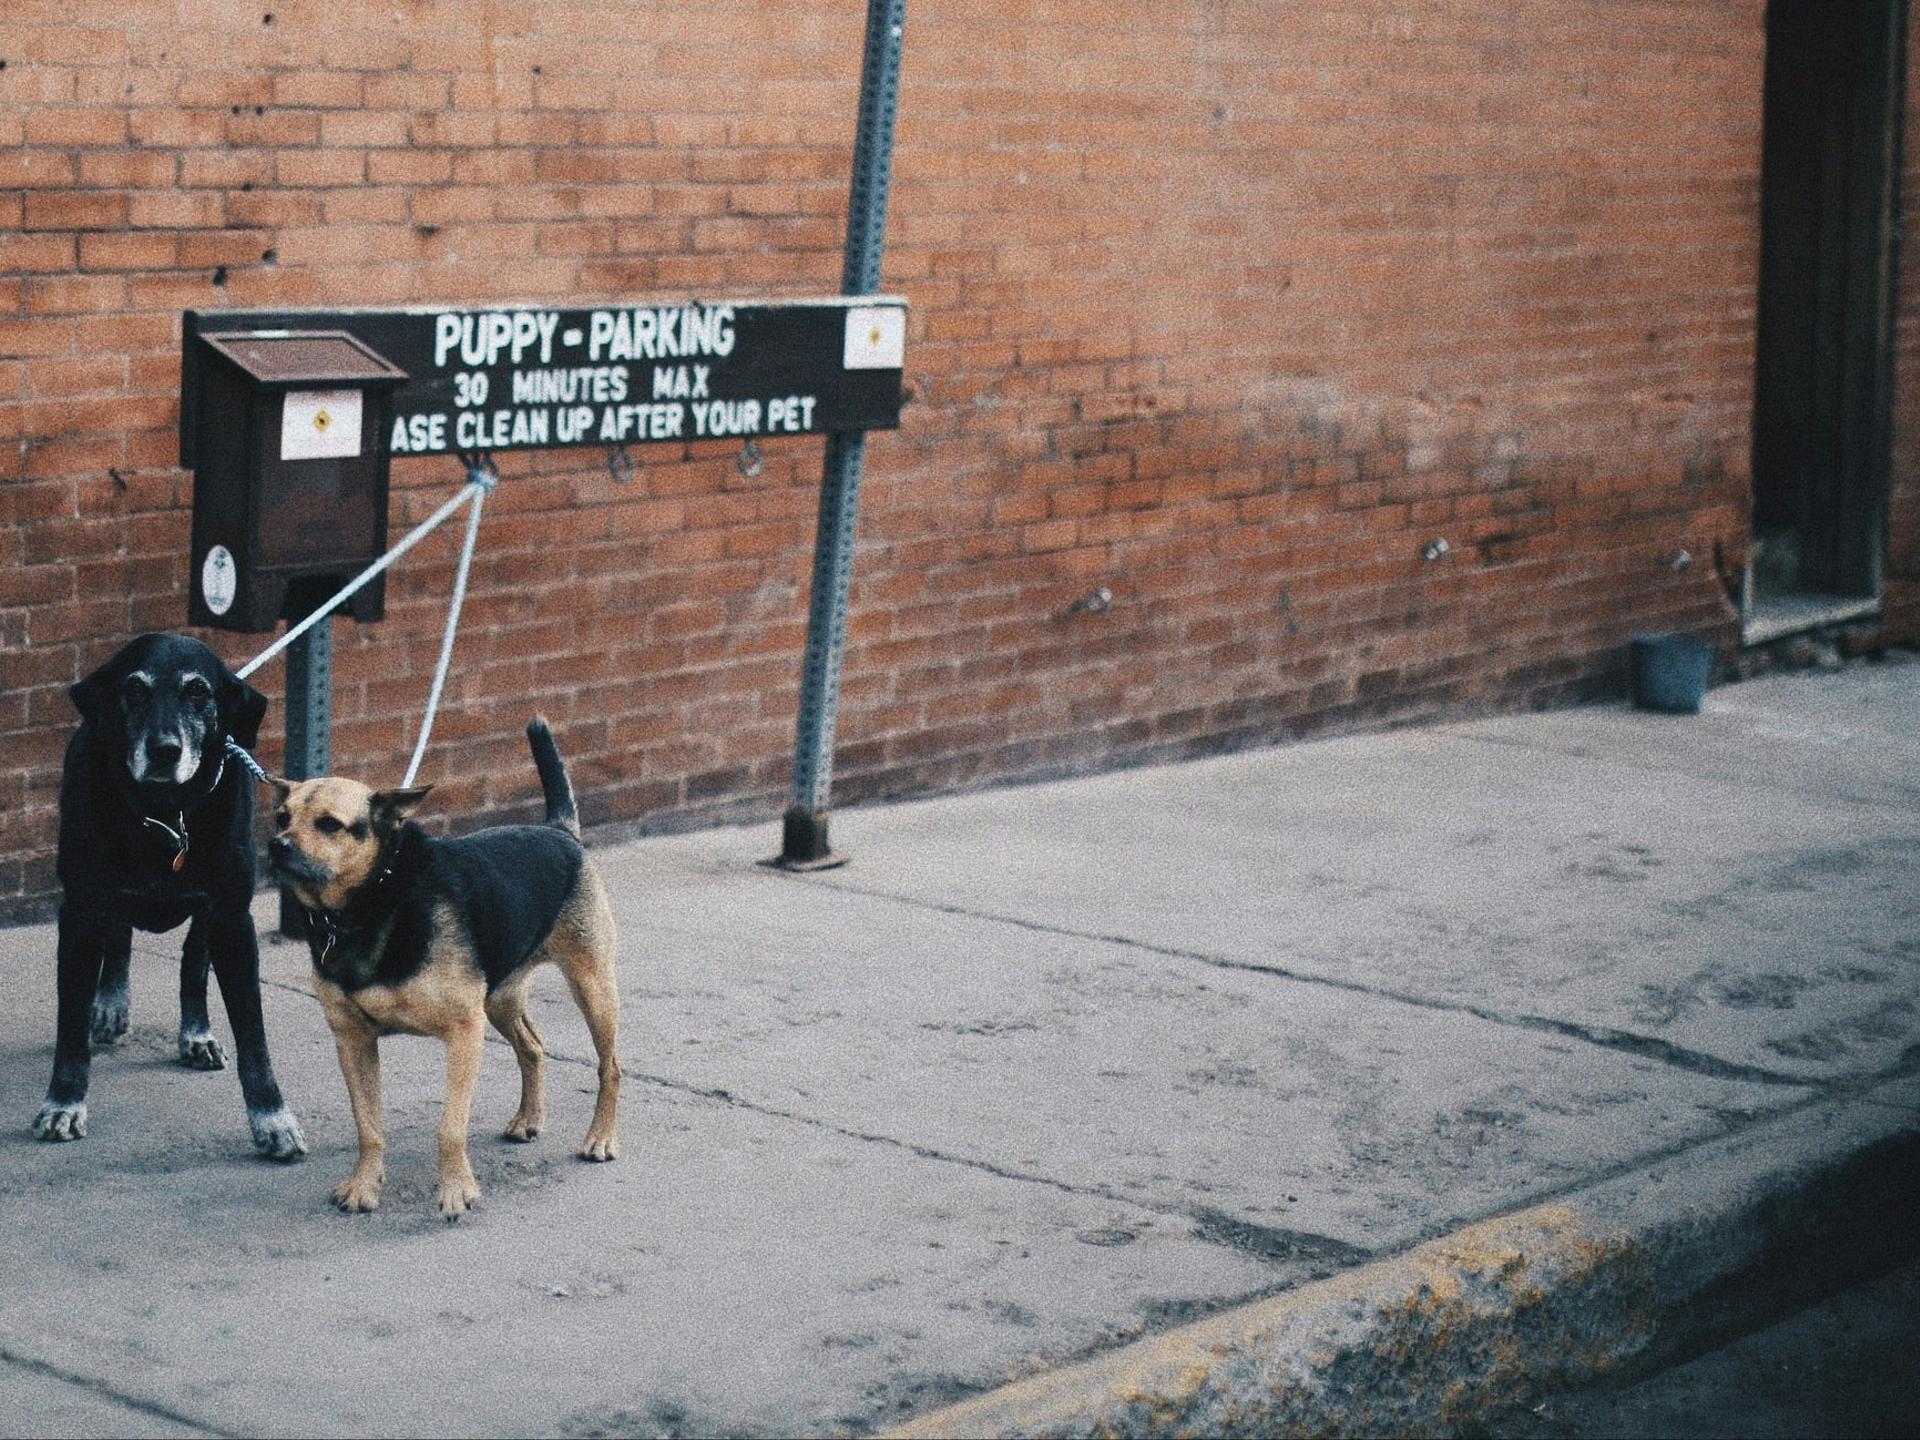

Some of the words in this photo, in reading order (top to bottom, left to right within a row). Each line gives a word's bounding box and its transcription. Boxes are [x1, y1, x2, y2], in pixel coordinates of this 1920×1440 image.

[454, 371, 489, 407] 30
[512, 366, 629, 404] MINUTES
[652, 365, 710, 399] MAX
[390, 414, 447, 452] ASE
[456, 409, 549, 449] CLEAN
[556, 406, 595, 442] UP
[599, 401, 684, 441] AFTER
[691, 399, 762, 436] YOUR
[767, 395, 816, 431] PET
